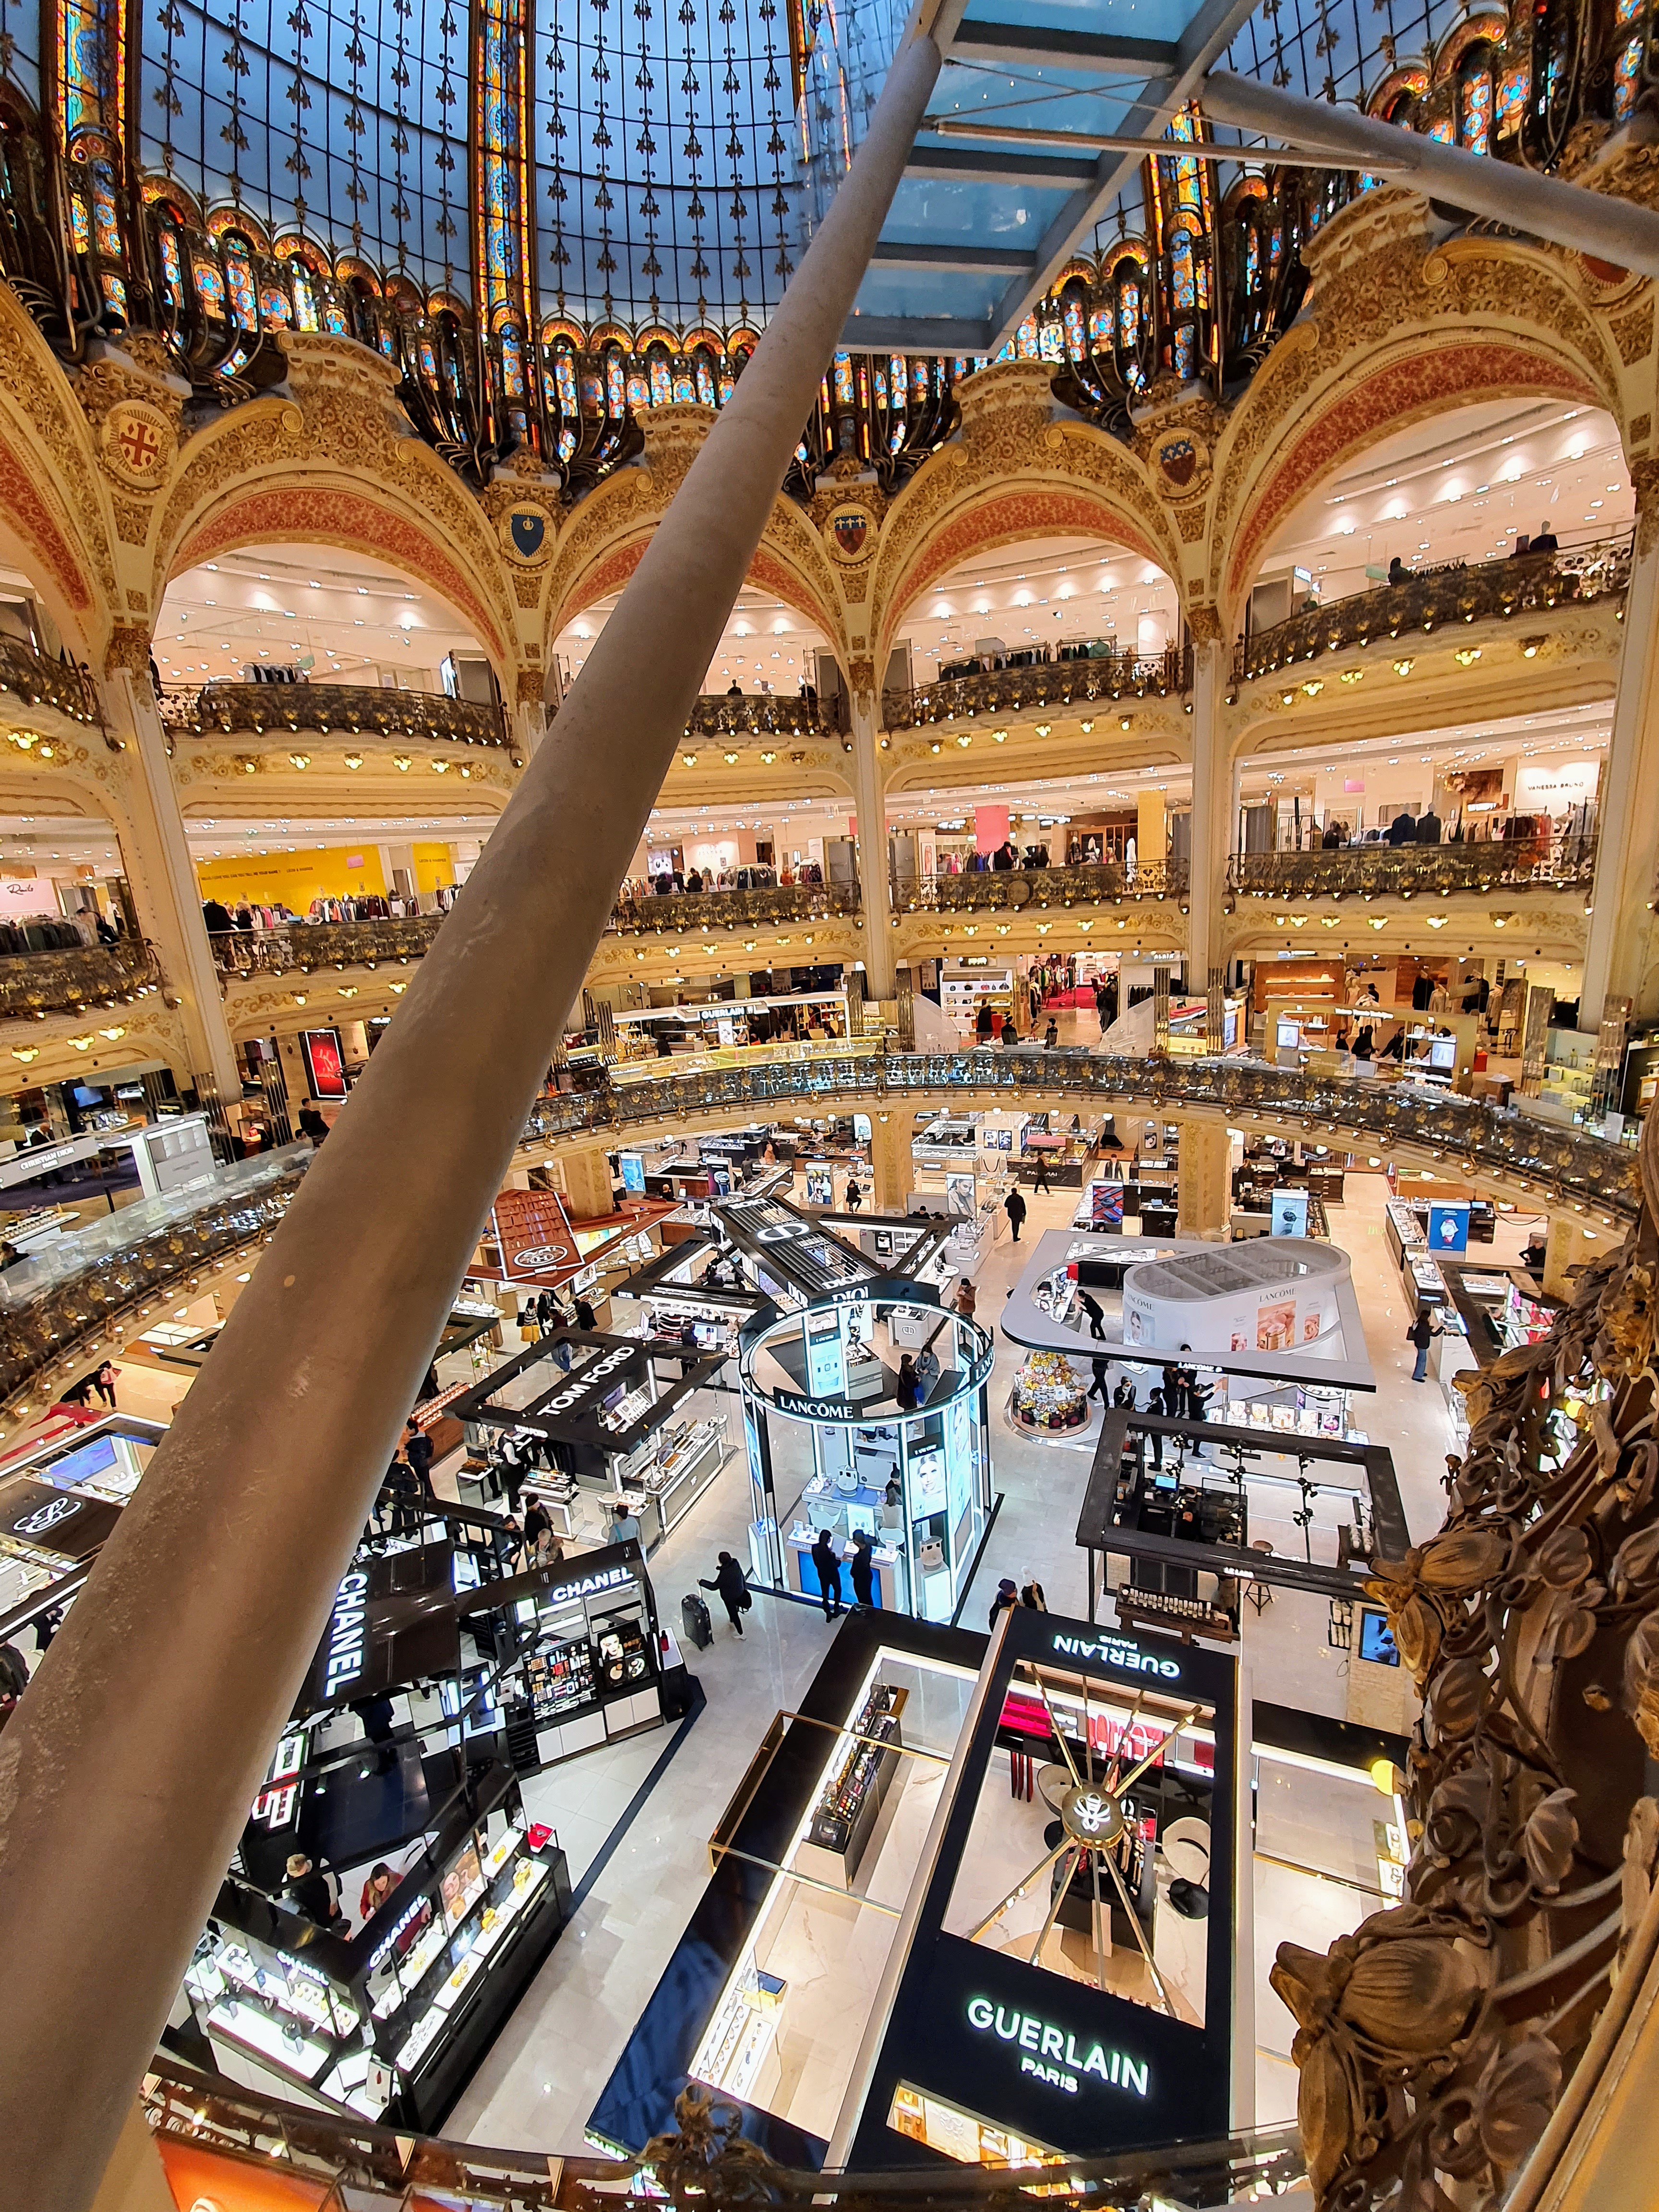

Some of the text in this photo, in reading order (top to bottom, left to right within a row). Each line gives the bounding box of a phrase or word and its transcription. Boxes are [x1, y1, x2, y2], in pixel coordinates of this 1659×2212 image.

[701, 1007, 745, 1019] GUERLAIN
[20, 1146, 75, 1170] CHRISTIAN DIOR
[787, 1281, 808, 1309] DIOR
[821, 1273, 871, 1290] DIOR
[536, 1346, 635, 1416] TOM FORD
[780, 1395, 854, 1419] LANCÔME
[552, 1567, 634, 1601] CHANEL
[325, 1573, 368, 1697] CHANEL
[1098, 1635, 1138, 1651] PARIS
[1053, 1635, 1181, 1678] GUERLAIN
[369, 1895, 428, 1968] CHANEL
[276, 1951, 329, 1986] CHANEL
[967, 1997, 1149, 2096] GUERLAIN
[1020, 2056, 1079, 2093] PARIS
